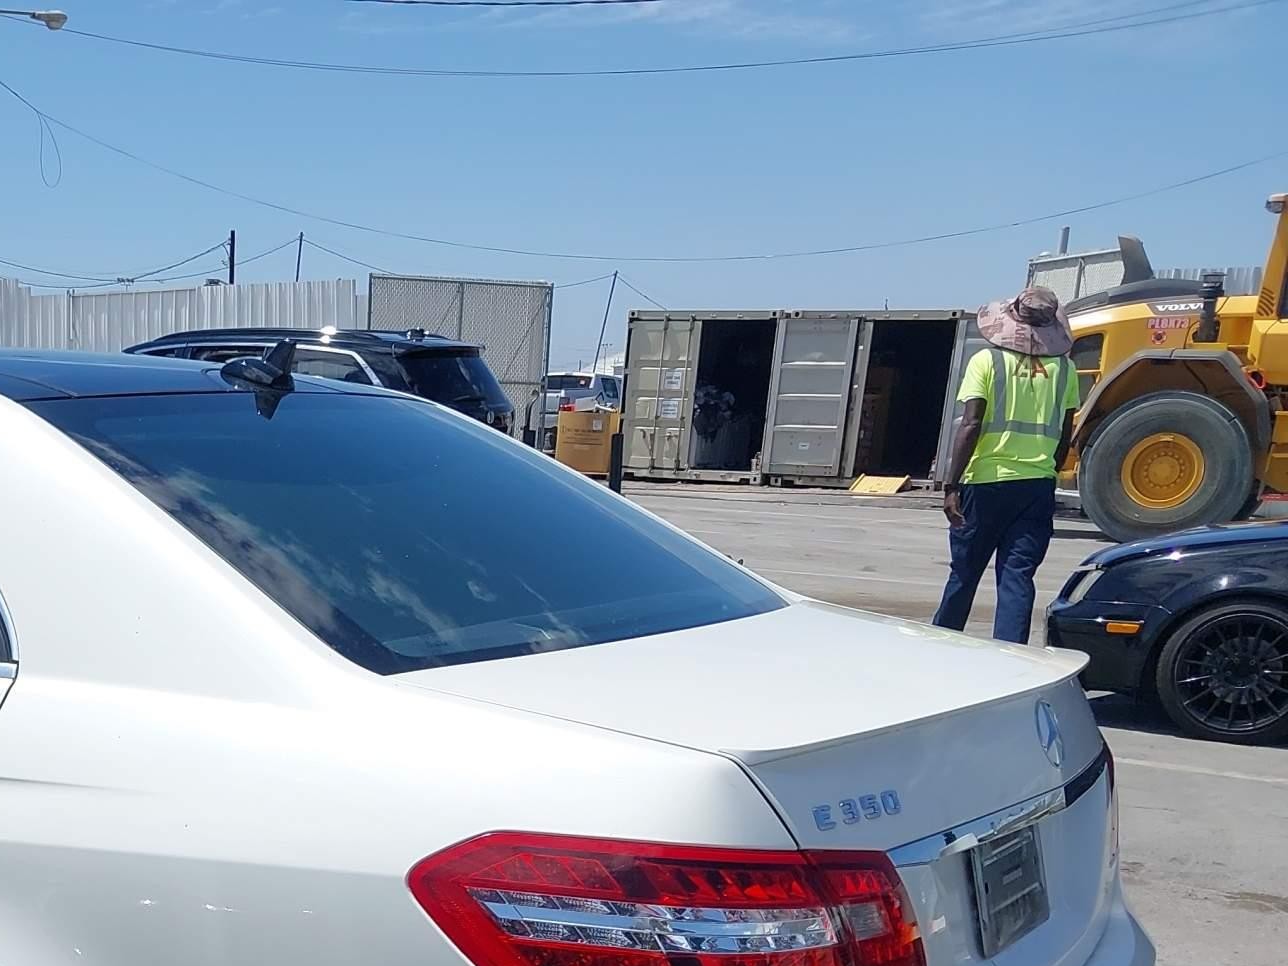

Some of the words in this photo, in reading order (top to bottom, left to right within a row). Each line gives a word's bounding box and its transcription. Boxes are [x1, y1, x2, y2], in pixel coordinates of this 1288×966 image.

[1155, 302, 1204, 312] VOLV
[812, 805, 837, 831] E
[839, 790, 902, 824] 350
